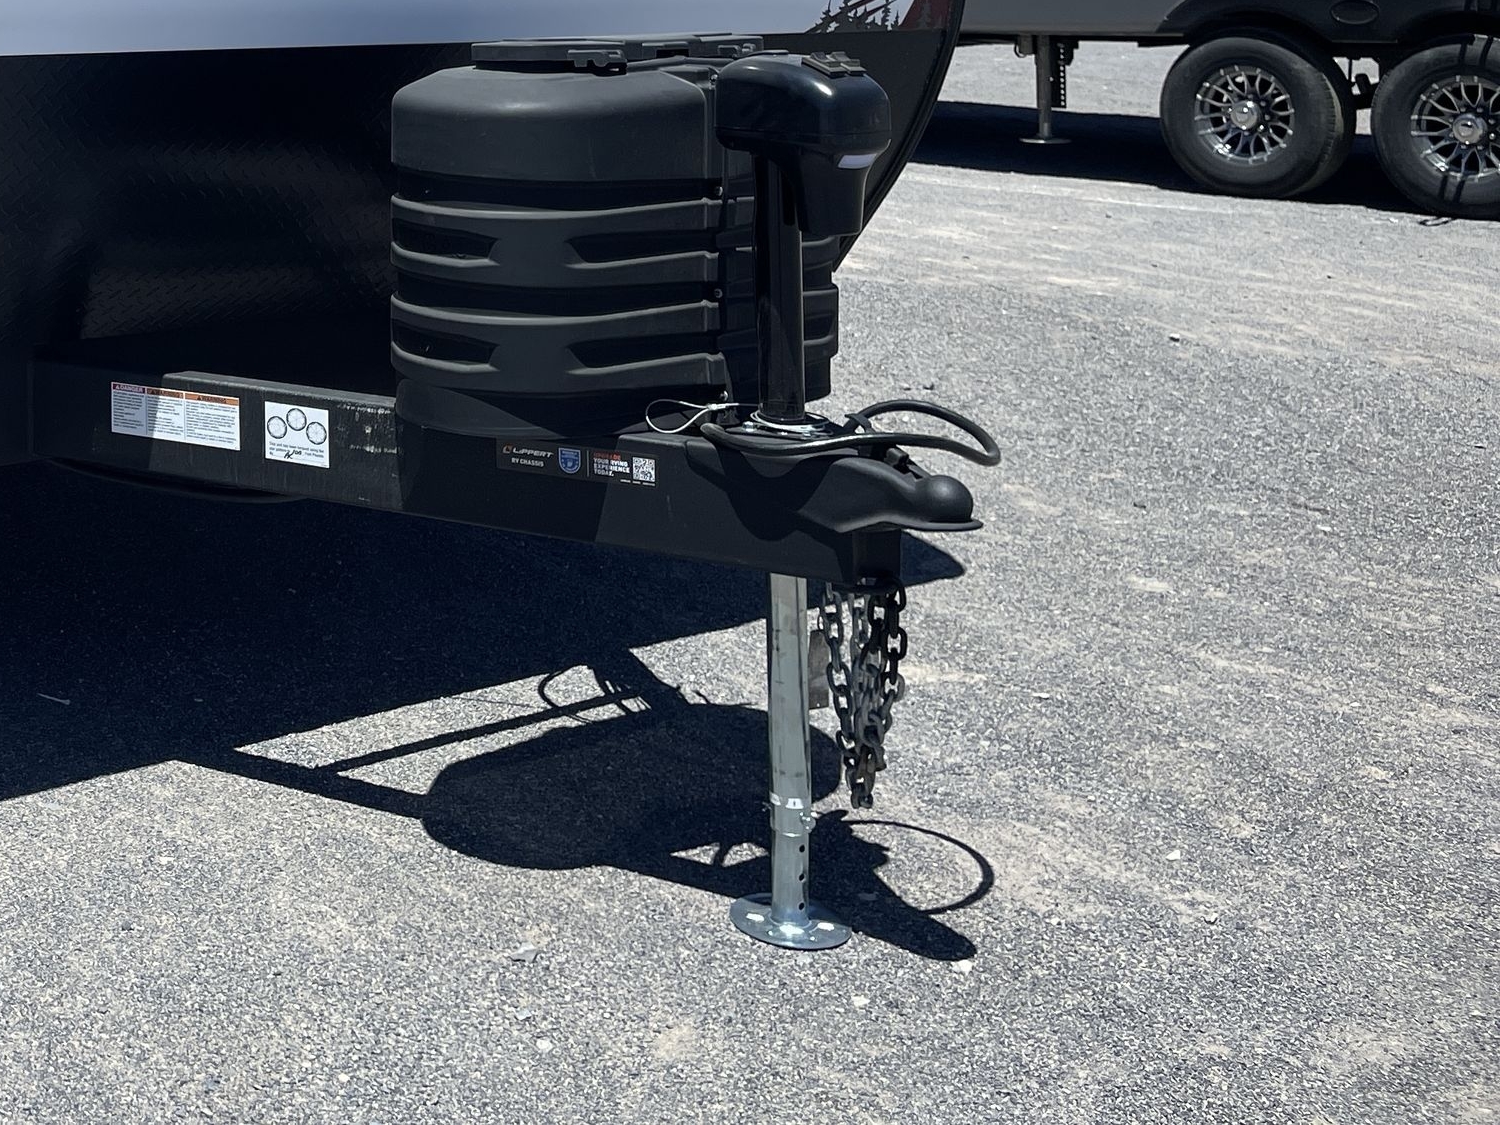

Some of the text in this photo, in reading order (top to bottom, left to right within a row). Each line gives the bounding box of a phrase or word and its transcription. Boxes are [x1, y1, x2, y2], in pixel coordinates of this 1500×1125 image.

[512, 447, 554, 458] LIPPERT
[519, 458, 545, 467] CHASSIS
[593, 463, 630, 473] EXPERIENCE
